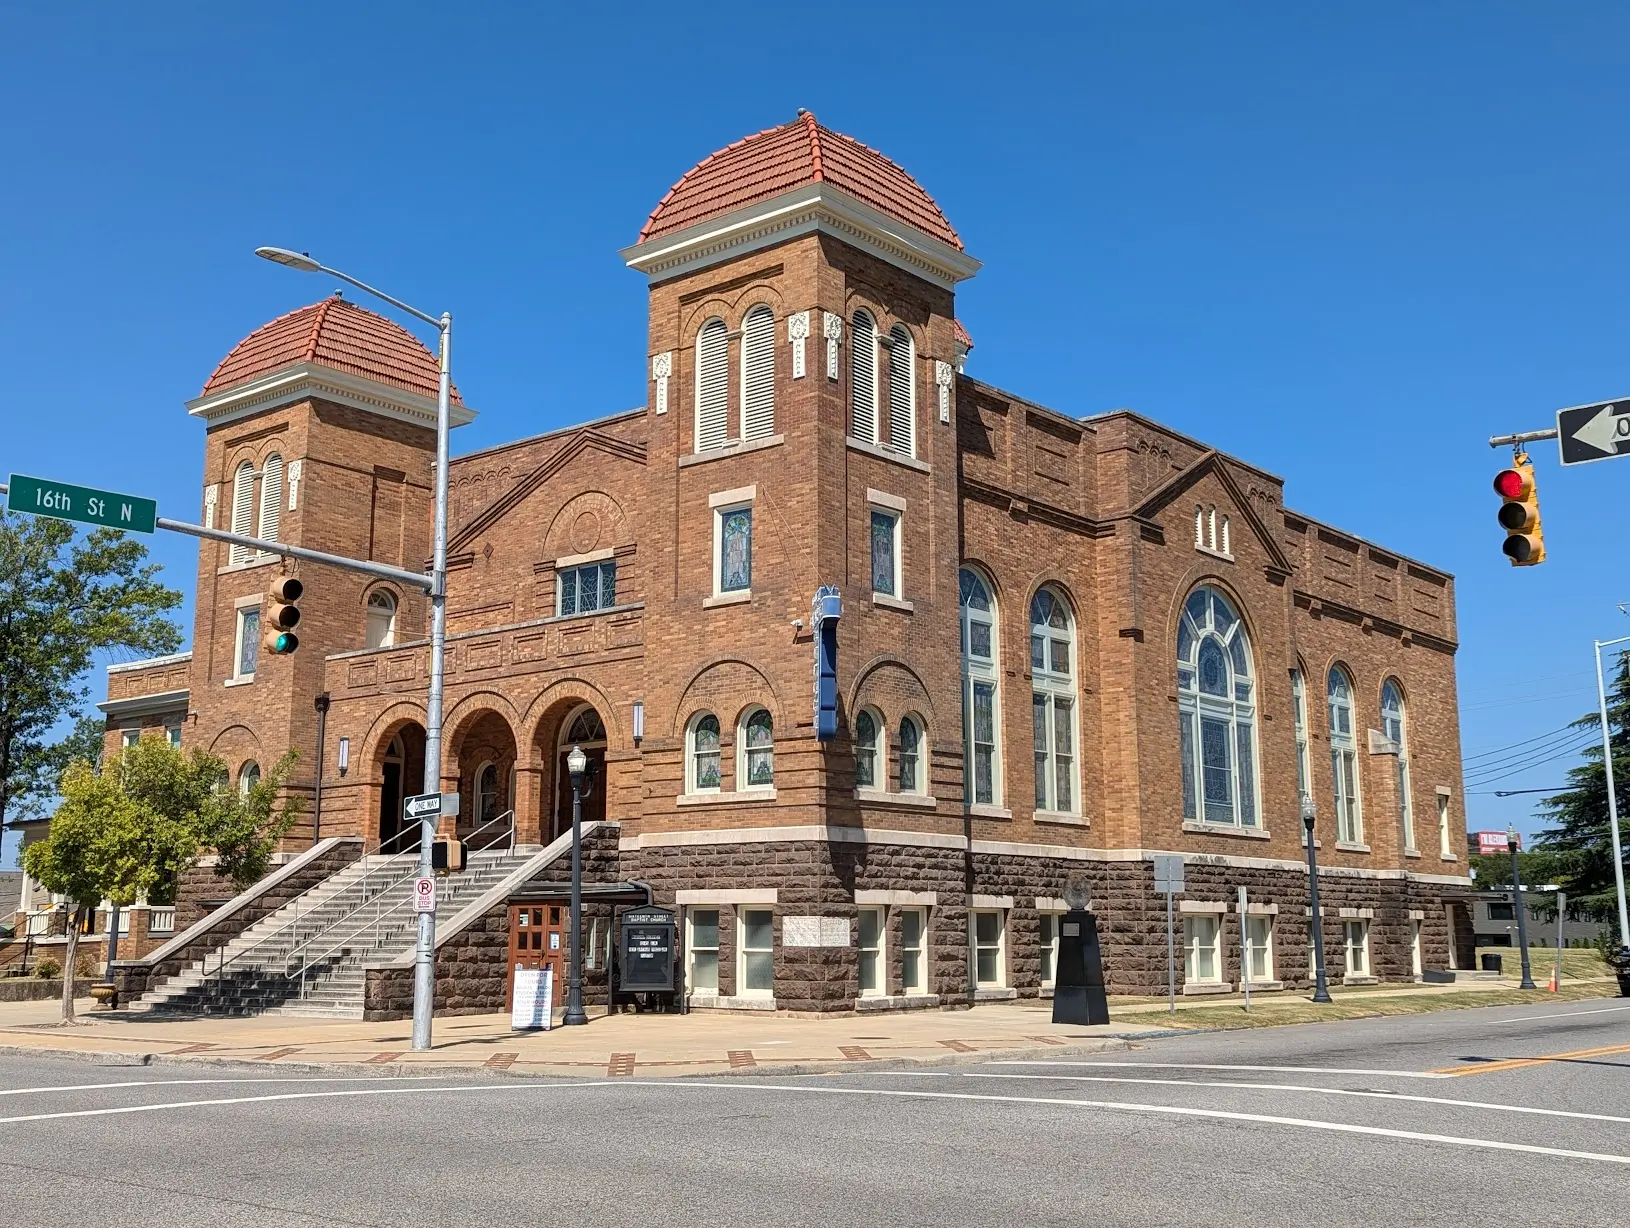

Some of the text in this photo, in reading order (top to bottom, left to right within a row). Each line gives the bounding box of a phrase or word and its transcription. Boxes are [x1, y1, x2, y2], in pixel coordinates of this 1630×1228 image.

[36, 488, 132, 522] 16th St N
[415, 799, 438, 811] ONE WAY
